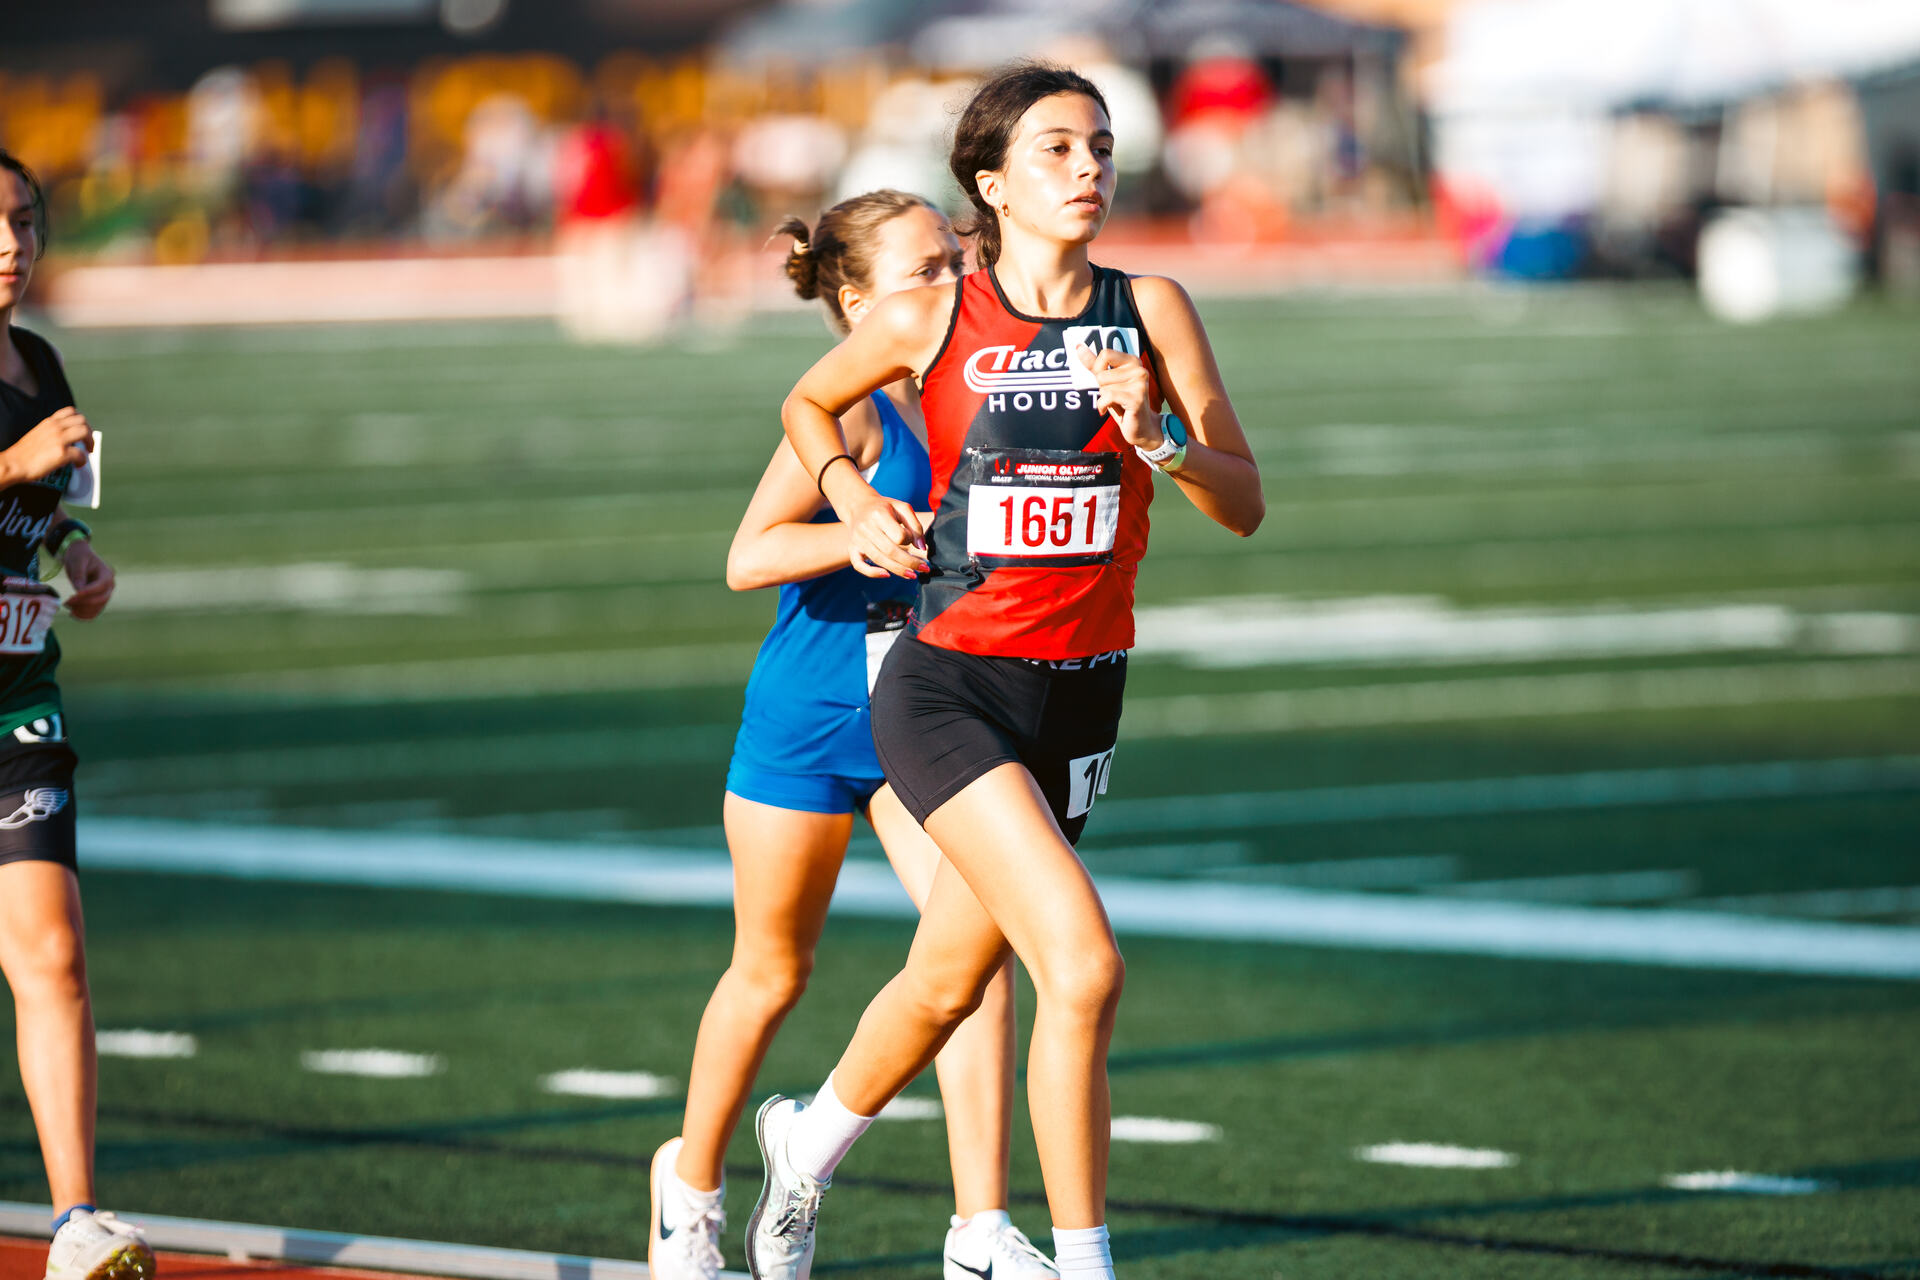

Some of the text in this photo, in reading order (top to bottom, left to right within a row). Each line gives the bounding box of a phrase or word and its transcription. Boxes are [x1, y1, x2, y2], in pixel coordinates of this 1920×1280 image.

[972, 345, 1070, 371] Trac
[1017, 464, 1102, 475] JUNIOR OLYMPIC
[0, 496, 54, 549] ing
[1000, 495, 1098, 547] 1651
